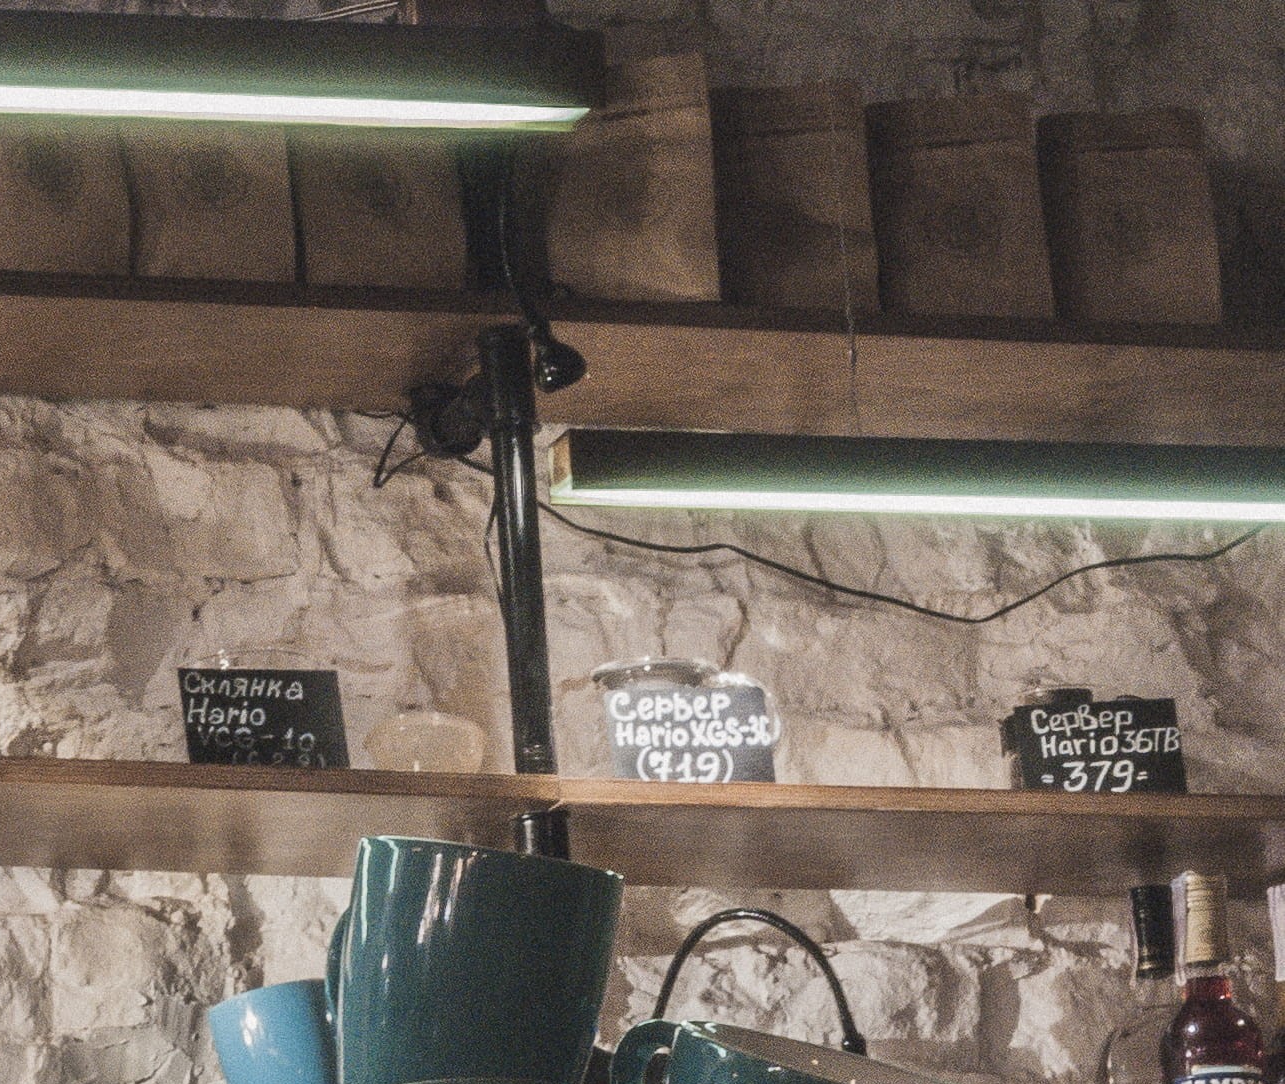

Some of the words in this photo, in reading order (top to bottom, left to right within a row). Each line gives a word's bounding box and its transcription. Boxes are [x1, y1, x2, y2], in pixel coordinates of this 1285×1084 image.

[184, 671, 304, 701] Склянка
[187, 697, 266, 726] Hario
[1031, 704, 1132, 737] Сервер
